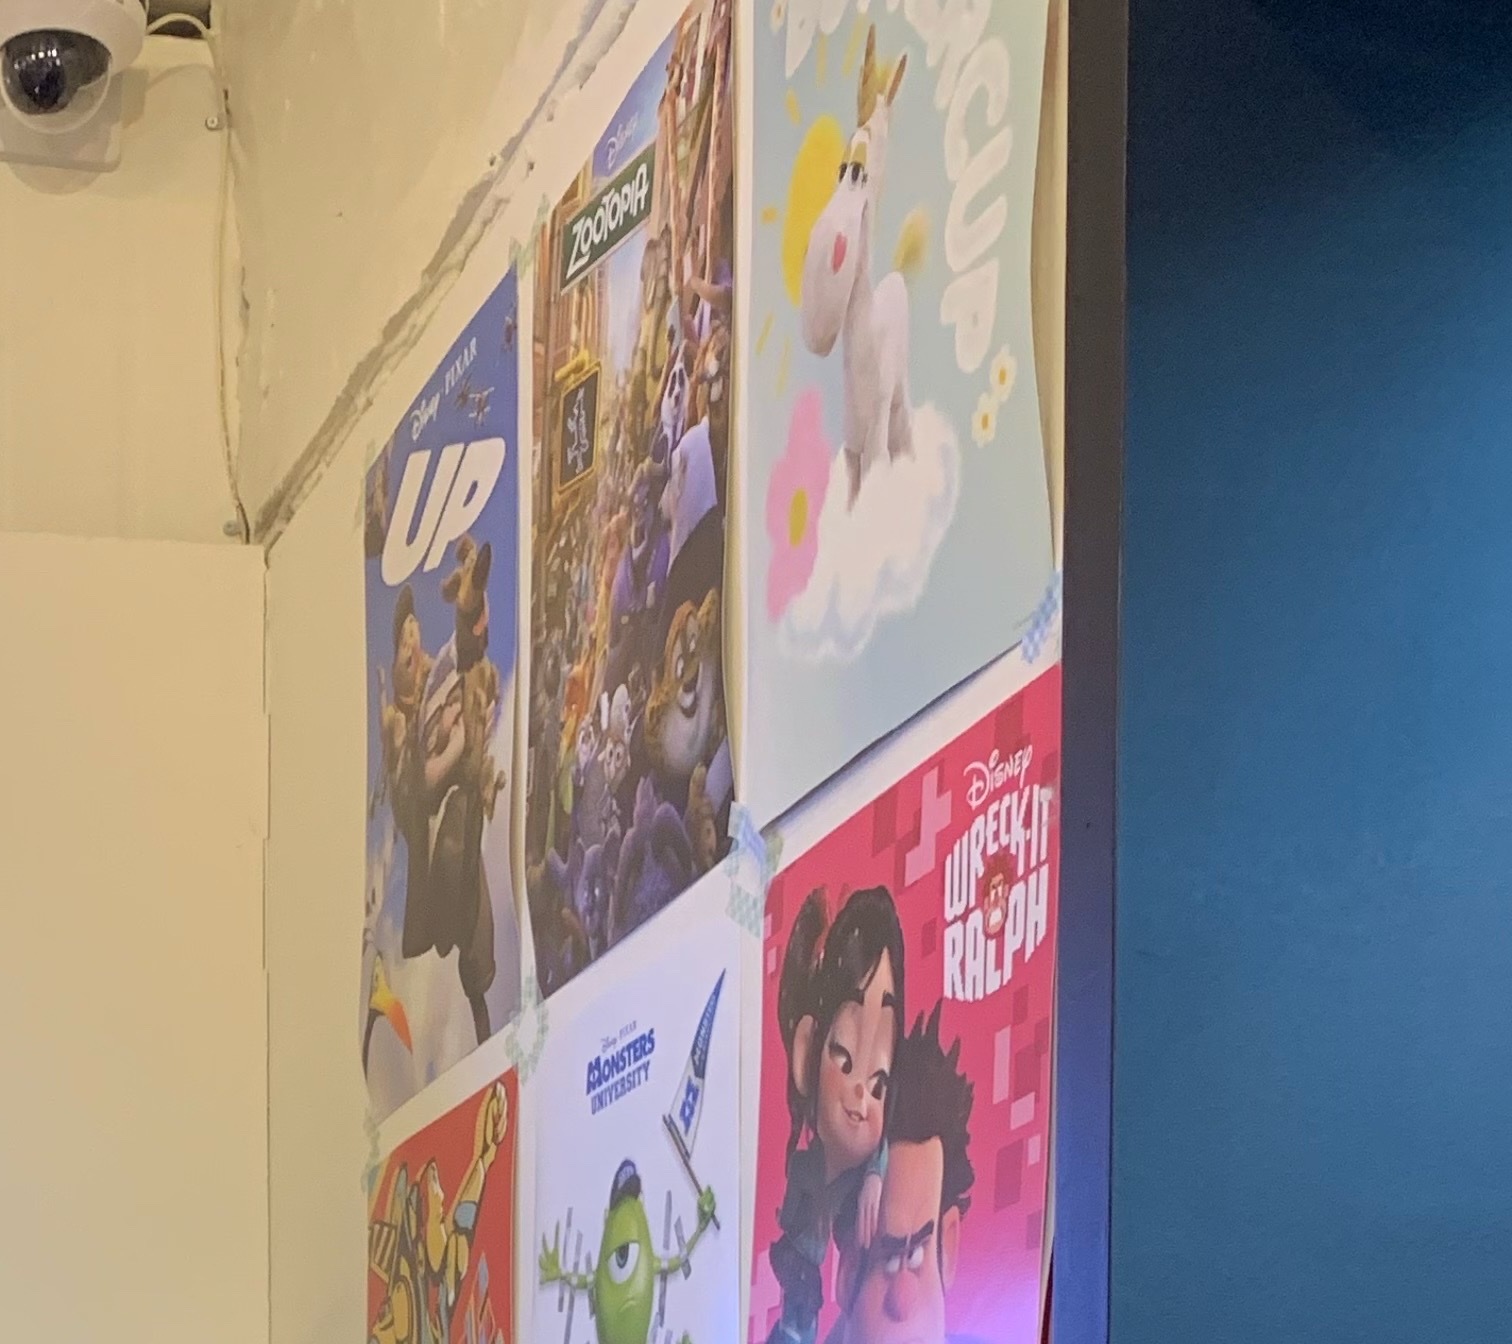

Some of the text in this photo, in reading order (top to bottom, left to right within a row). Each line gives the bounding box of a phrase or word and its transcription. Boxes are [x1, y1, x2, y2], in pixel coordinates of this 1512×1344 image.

[566, 162, 650, 280] ZOOTOPIA
[444, 337, 477, 396] PIXAR
[381, 437, 506, 587] UP
[944, 783, 1053, 924] WRECK-IT
[943, 864, 1049, 1002] RALPH
[591, 1060, 650, 1115] UNIVERSITY
[619, 1020, 637, 1040] PIXAR
